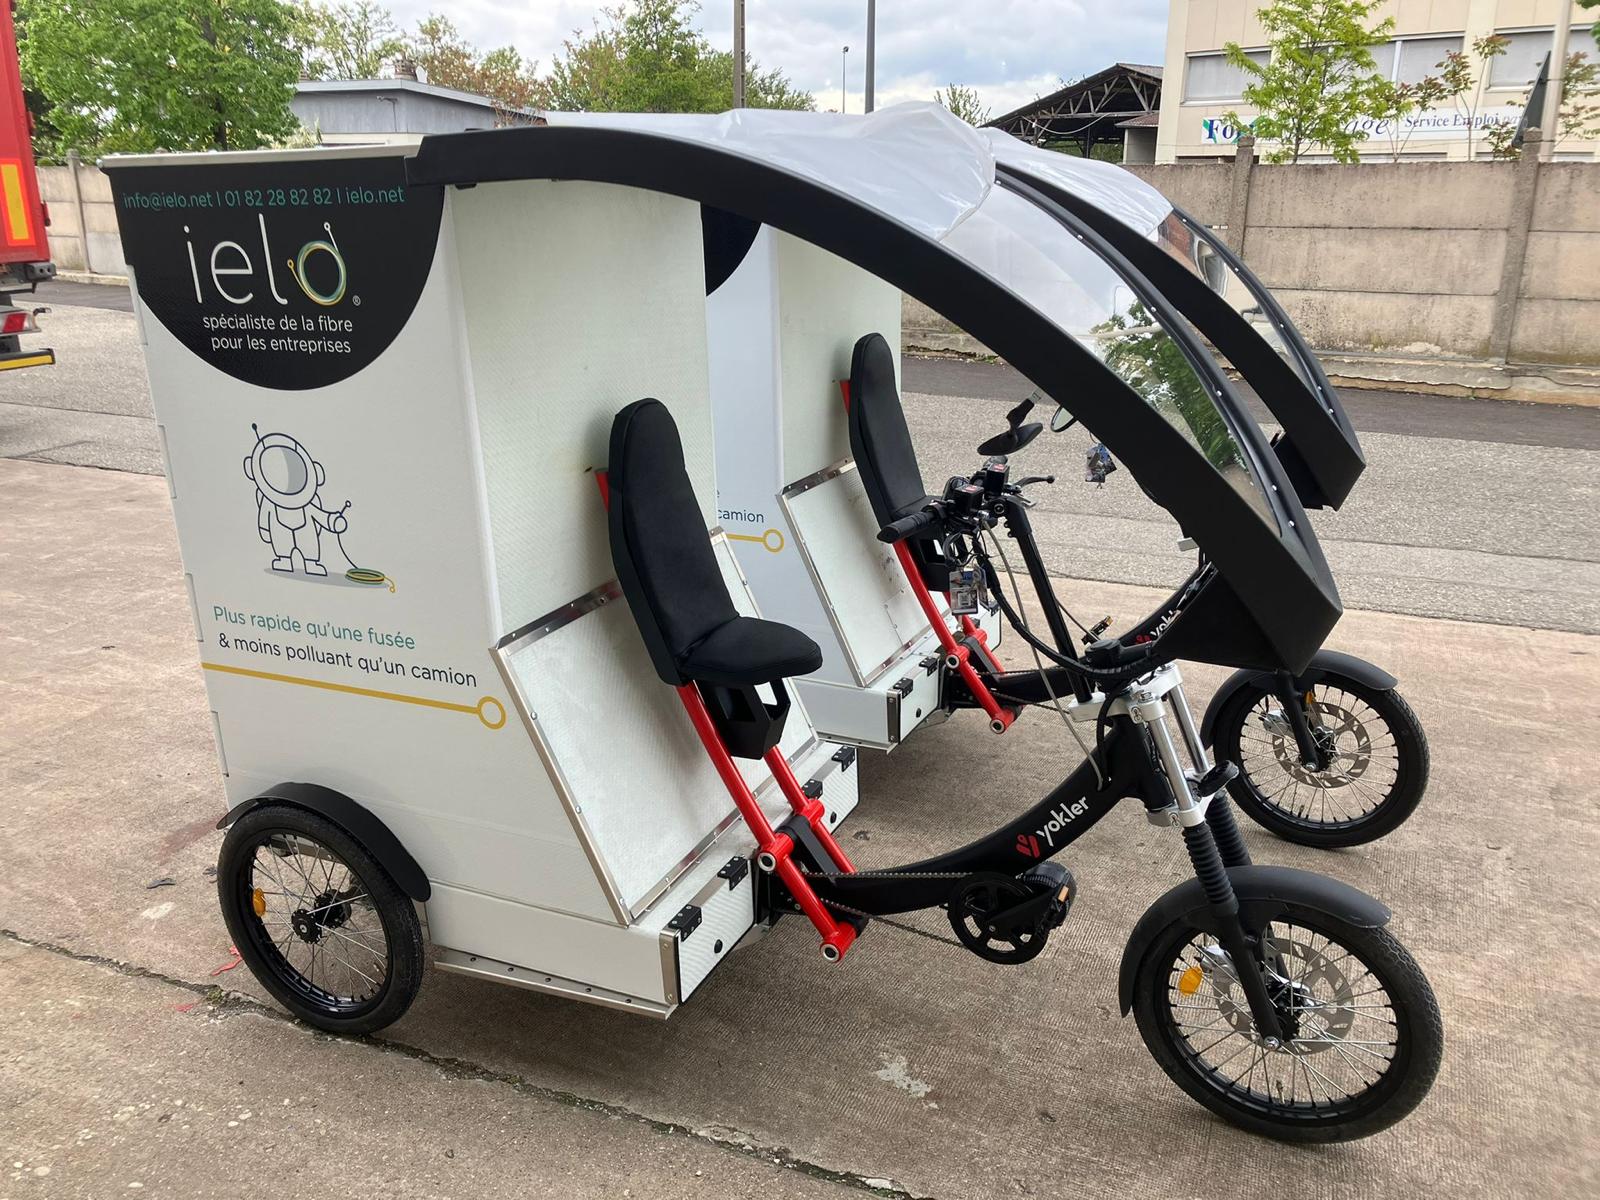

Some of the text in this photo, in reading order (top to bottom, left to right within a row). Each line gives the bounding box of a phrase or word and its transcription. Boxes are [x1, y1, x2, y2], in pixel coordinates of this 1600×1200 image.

[1405, 115, 1449, 128] Service
[122, 191, 213, 212] info@ielo.net
[224, 190, 241, 207] 01
[244, 189, 264, 207] 82
[266, 188, 286, 206] 28
[289, 188, 310, 206] 82
[312, 187, 333, 205] 82
[345, 186, 405, 204] ielo.net
[183, 213, 347, 306] ielo
[202, 313, 353, 332] spécialiste de la fibre
[211, 335, 351, 355] pour les entreprises
[213, 605, 416, 650] Plus rapide qu'une fusée
[219, 632, 478, 688] & moins polluant qu'un camion
[1035, 796, 1089, 847] yokler
